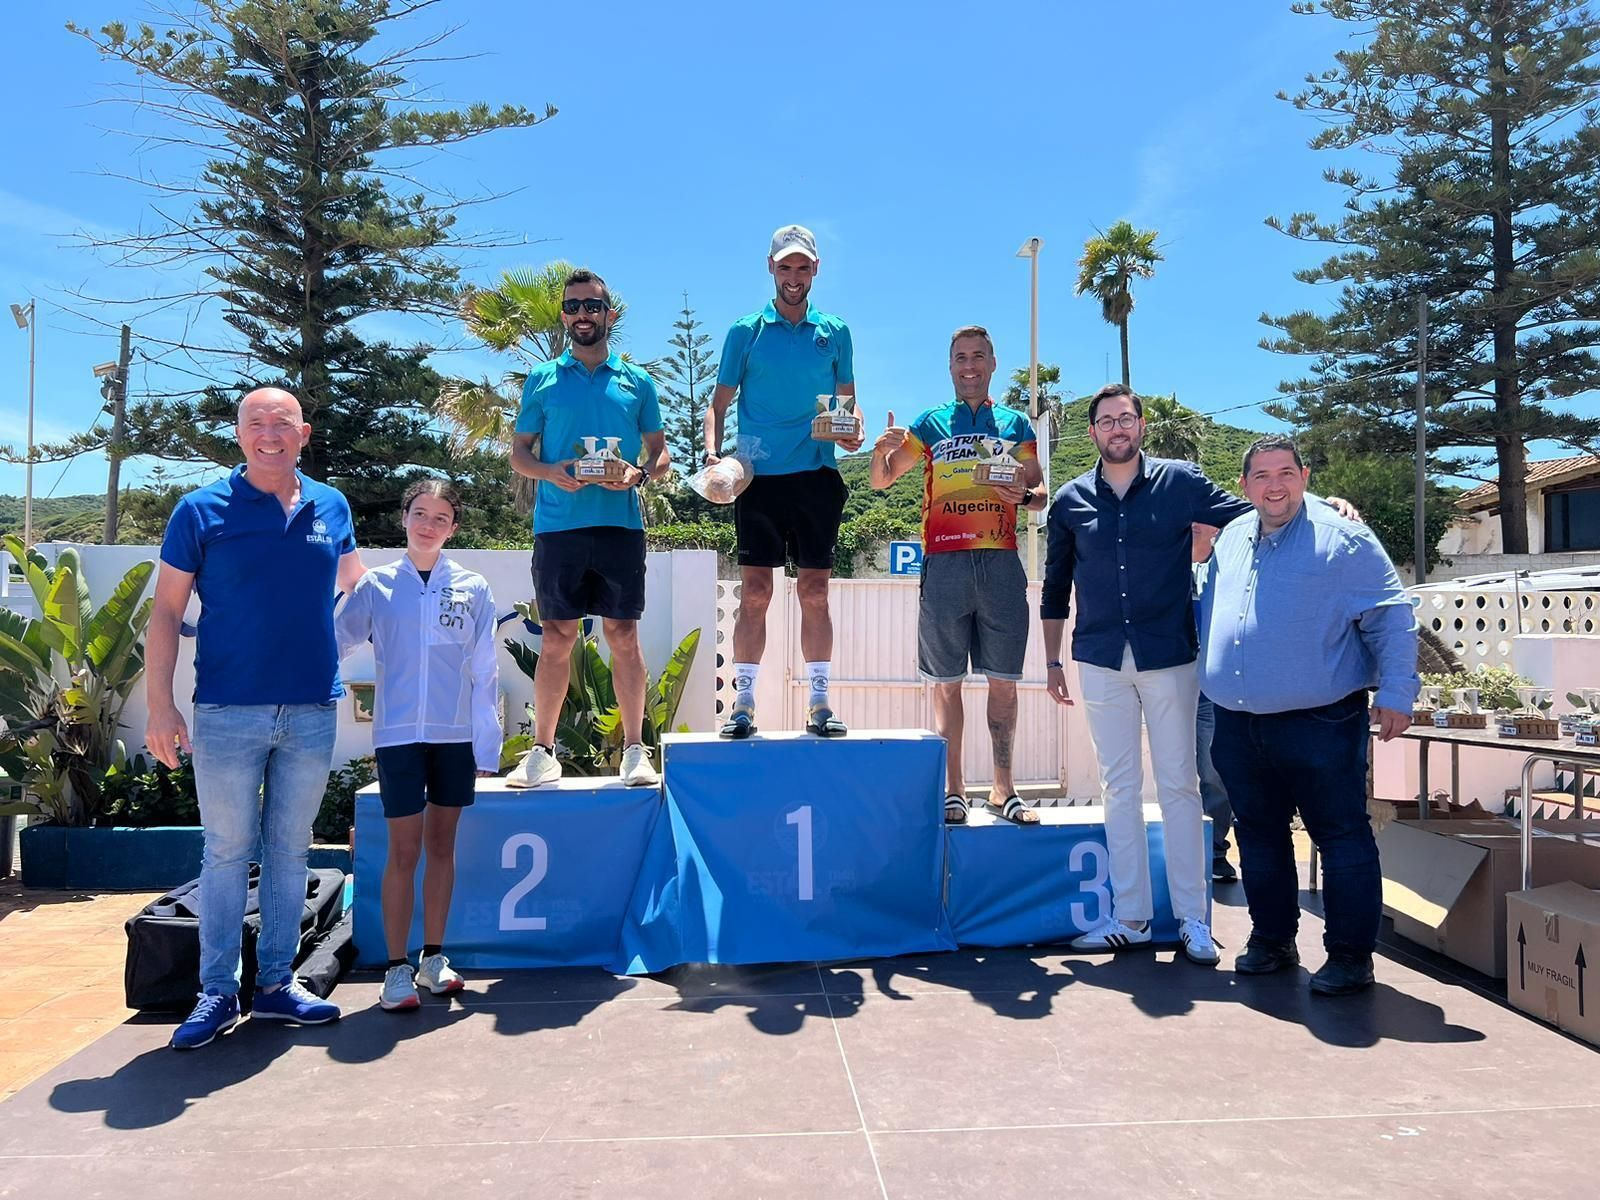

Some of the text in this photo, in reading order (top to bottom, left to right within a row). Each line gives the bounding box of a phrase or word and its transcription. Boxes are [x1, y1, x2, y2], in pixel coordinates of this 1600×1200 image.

[946, 449, 977, 461] TEAM
[943, 500, 1006, 516] Algeciras
[896, 546, 916, 571] P
[786, 805, 813, 900] 1
[499, 833, 548, 931] 2
[1069, 841, 1112, 933] 3
[1527, 961, 1576, 989] MUY FRAGIL
